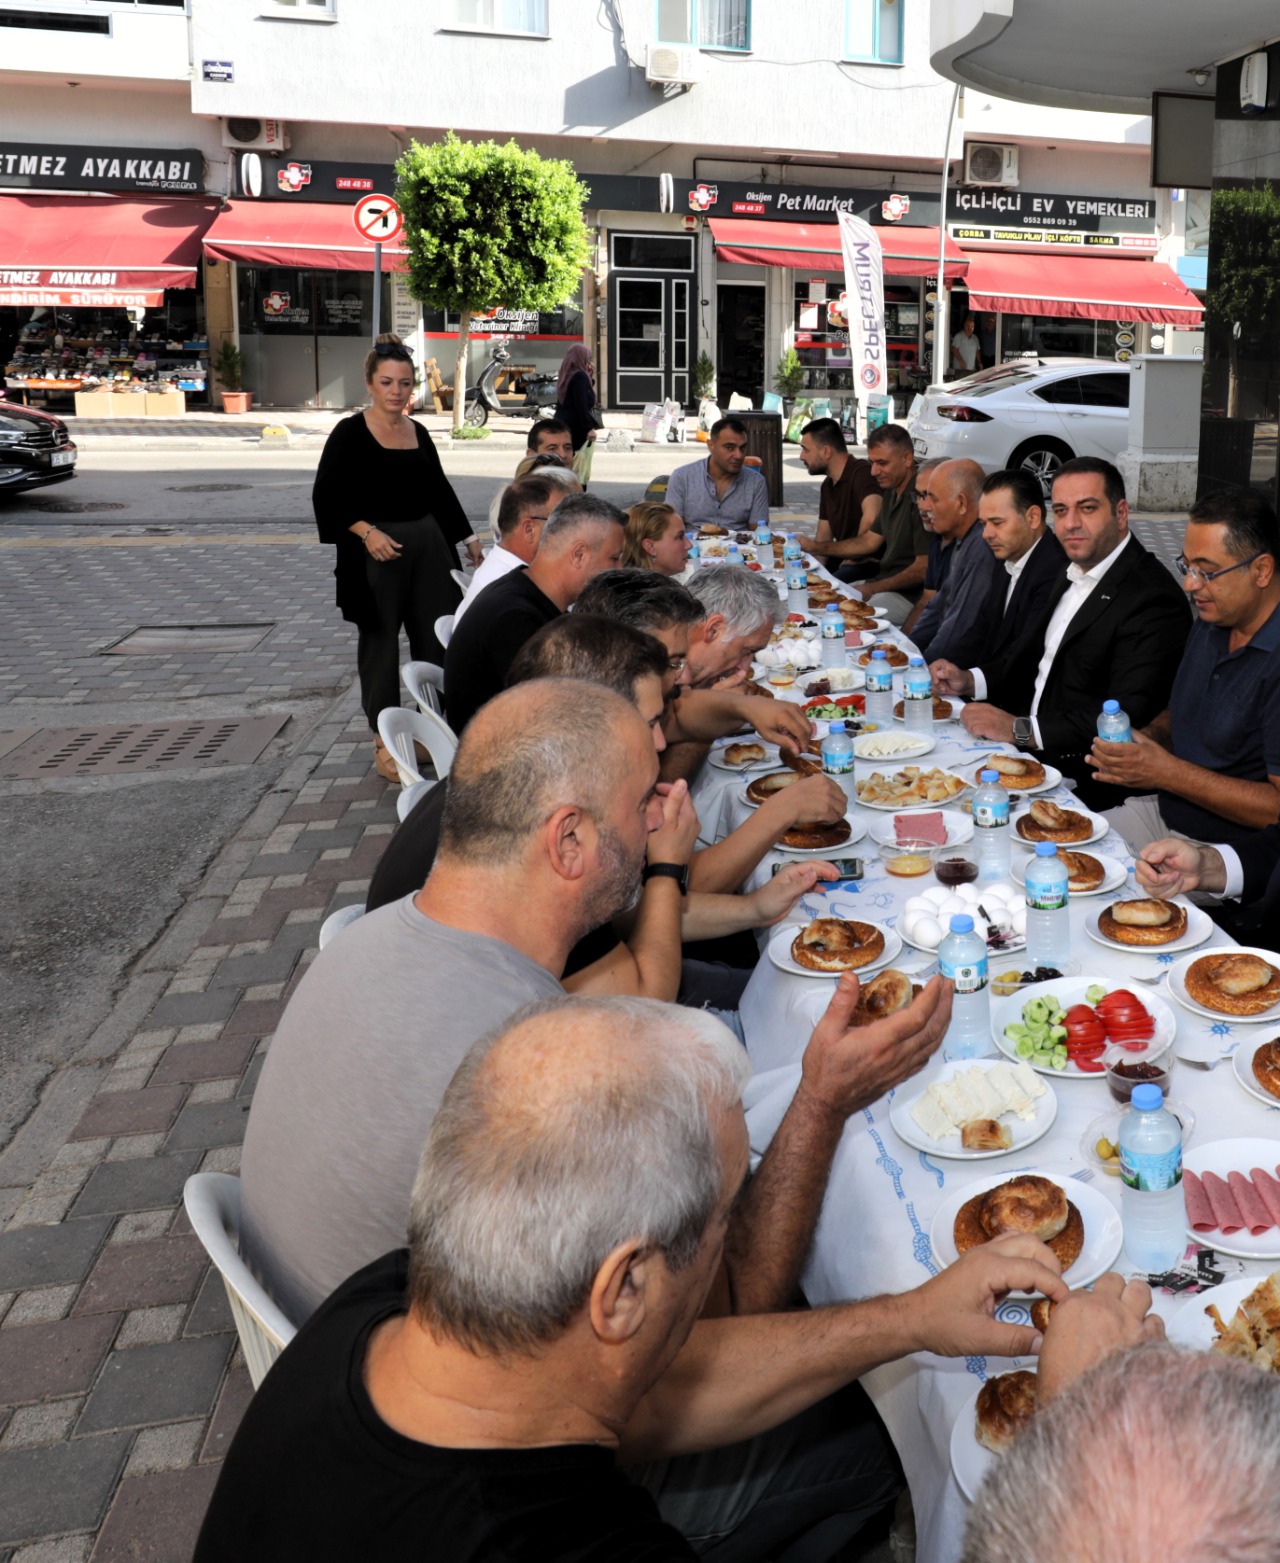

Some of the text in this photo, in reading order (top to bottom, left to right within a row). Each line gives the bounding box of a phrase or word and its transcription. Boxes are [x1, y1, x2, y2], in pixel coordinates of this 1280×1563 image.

[265, 118, 275, 143] VEST
[80, 157, 191, 181] AYAKKABI
[352, 180, 361, 188] 48
[745, 191, 772, 202] Oksijen
[776, 193, 854, 213] Pet Market
[955, 190, 1149, 218] İÇLİ-İÇLİ EV YEMEKLERİ
[1023, 216, 1077, 226] 0552 869 09 39
[958, 229, 985, 238] ÇORBA
[994, 231, 1042, 241] TAVUKLU PİLAV
[48, 271, 118, 285] AYAKKABI
[70, 293, 147, 305] SÜRÜYOR
[496, 307, 539, 323] Oksijen
